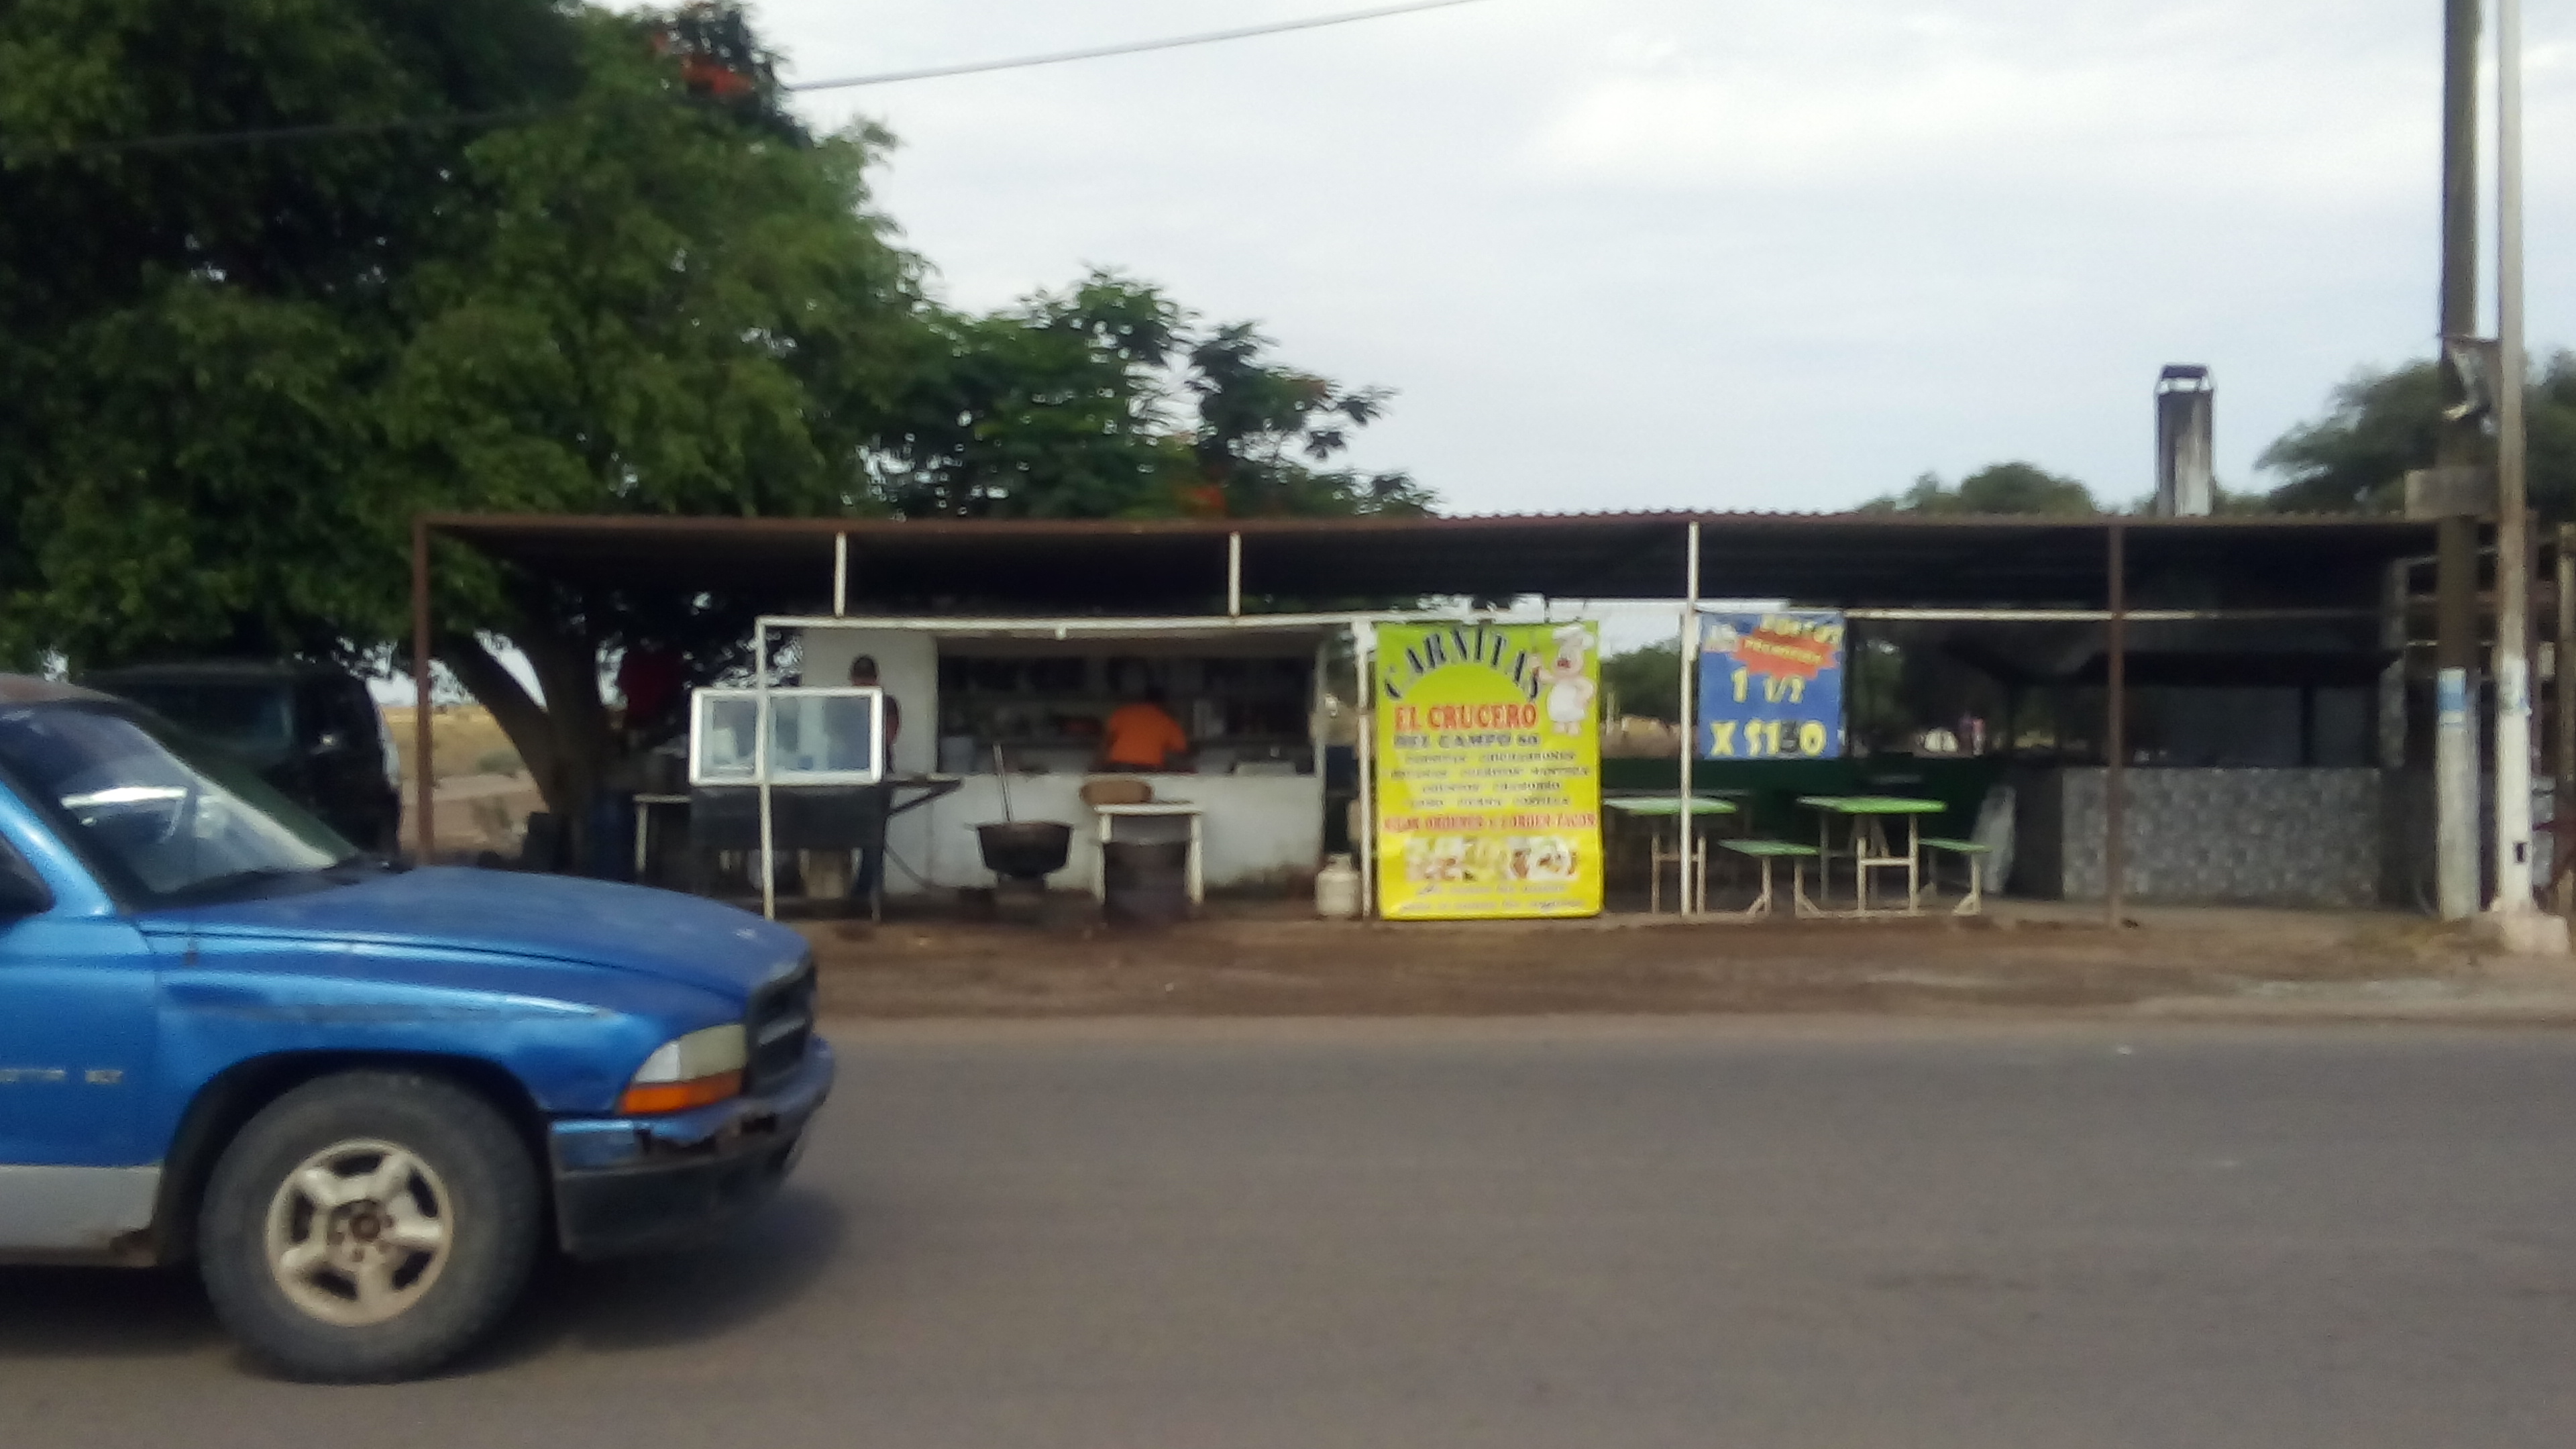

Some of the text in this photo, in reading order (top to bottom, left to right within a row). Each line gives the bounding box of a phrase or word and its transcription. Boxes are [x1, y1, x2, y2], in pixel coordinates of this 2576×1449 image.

[1383, 624, 1541, 702] CARNITAS
[1731, 666, 1749, 703] 1
[1394, 703, 1539, 731] EL CRUCERO
[1711, 720, 1738, 757] X
